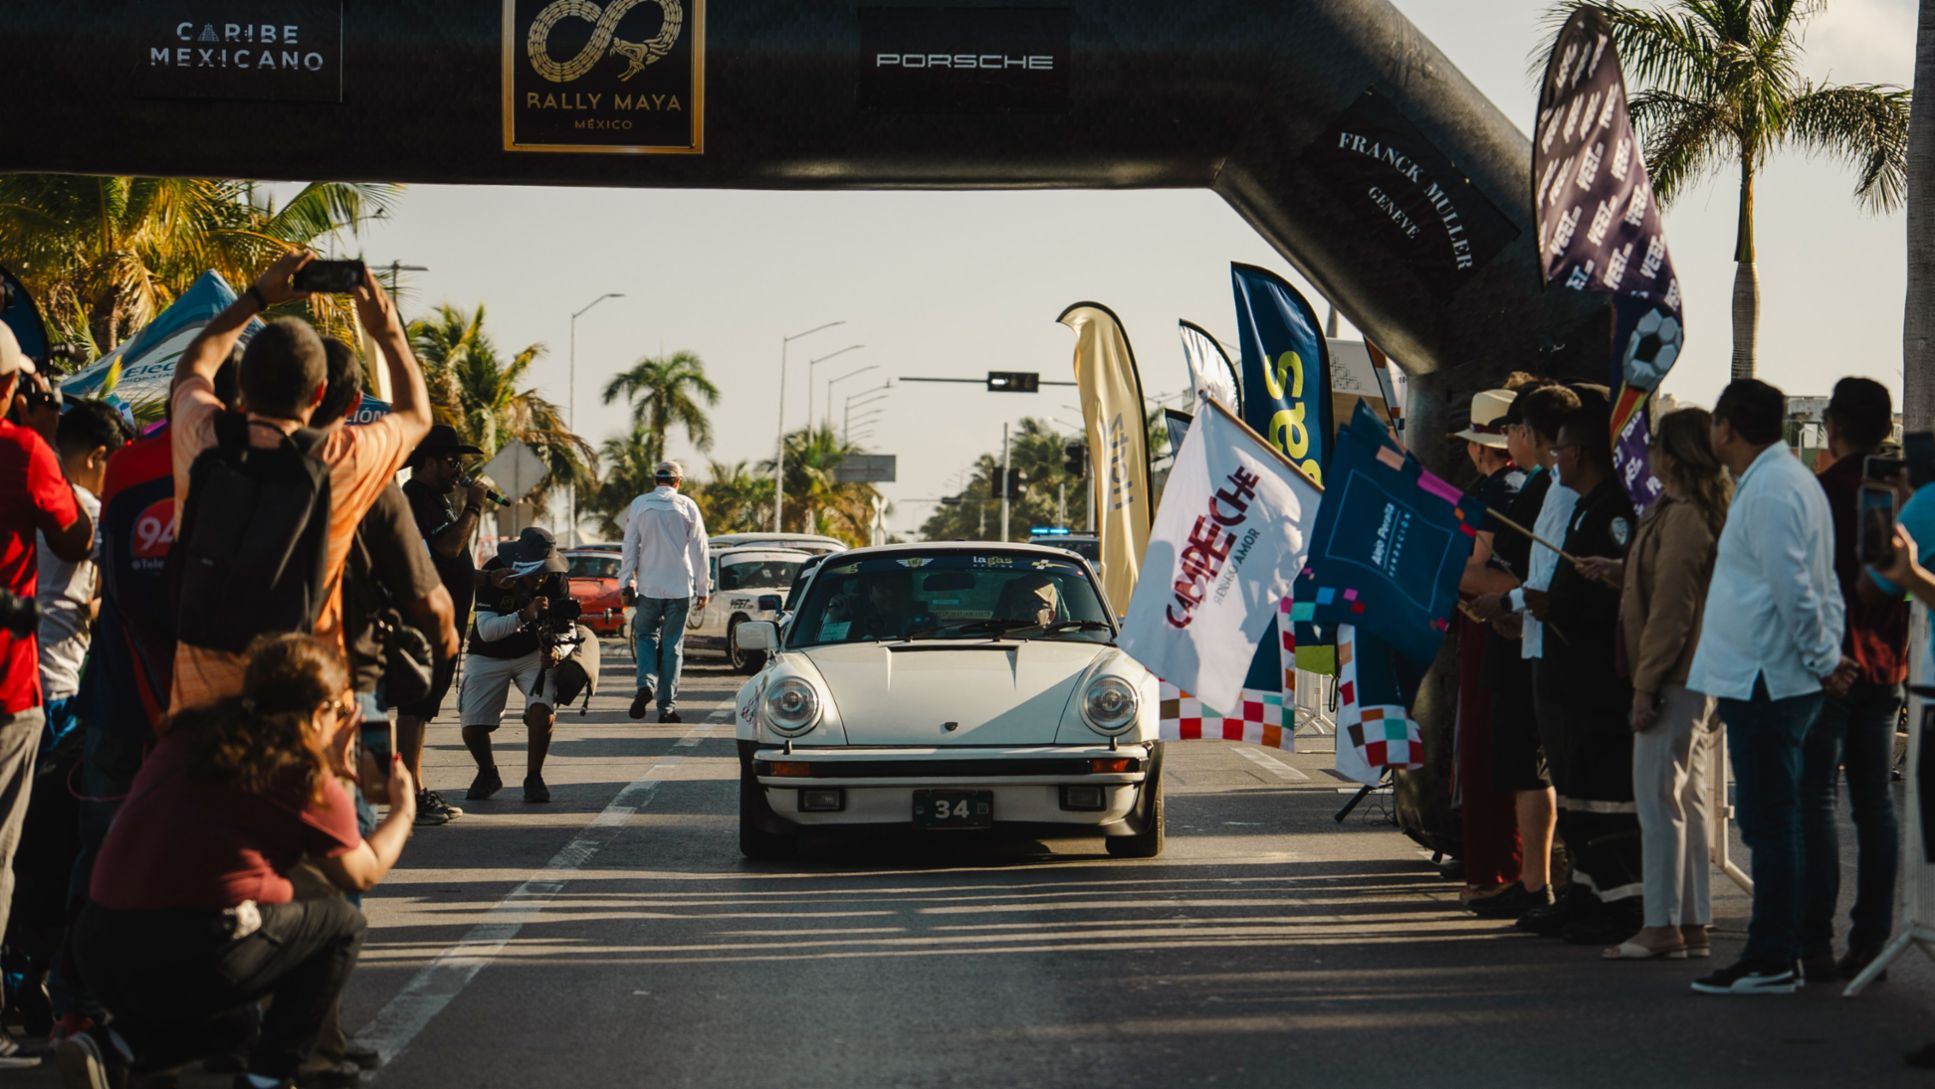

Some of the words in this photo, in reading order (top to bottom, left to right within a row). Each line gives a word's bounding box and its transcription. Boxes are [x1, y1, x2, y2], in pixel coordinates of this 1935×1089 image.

[176, 22, 299, 44] CARIBE
[150, 47, 324, 71] MEXICANO
[876, 53, 1053, 70] PORSCHE
[527, 91, 602, 110] RALLY
[614, 93, 682, 112] MAYA
[574, 117, 633, 130] MÉXICO
[1338, 132, 1424, 184] FRANCK
[1423, 181, 1473, 270] MULLER
[1368, 186, 1421, 239] GENEVE
[345, 407, 387, 423] IÓN
[1166, 466, 1260, 628] CAMPECHE
[1233, 527, 1261, 565] AMOR
[935, 799, 970, 820] 34
